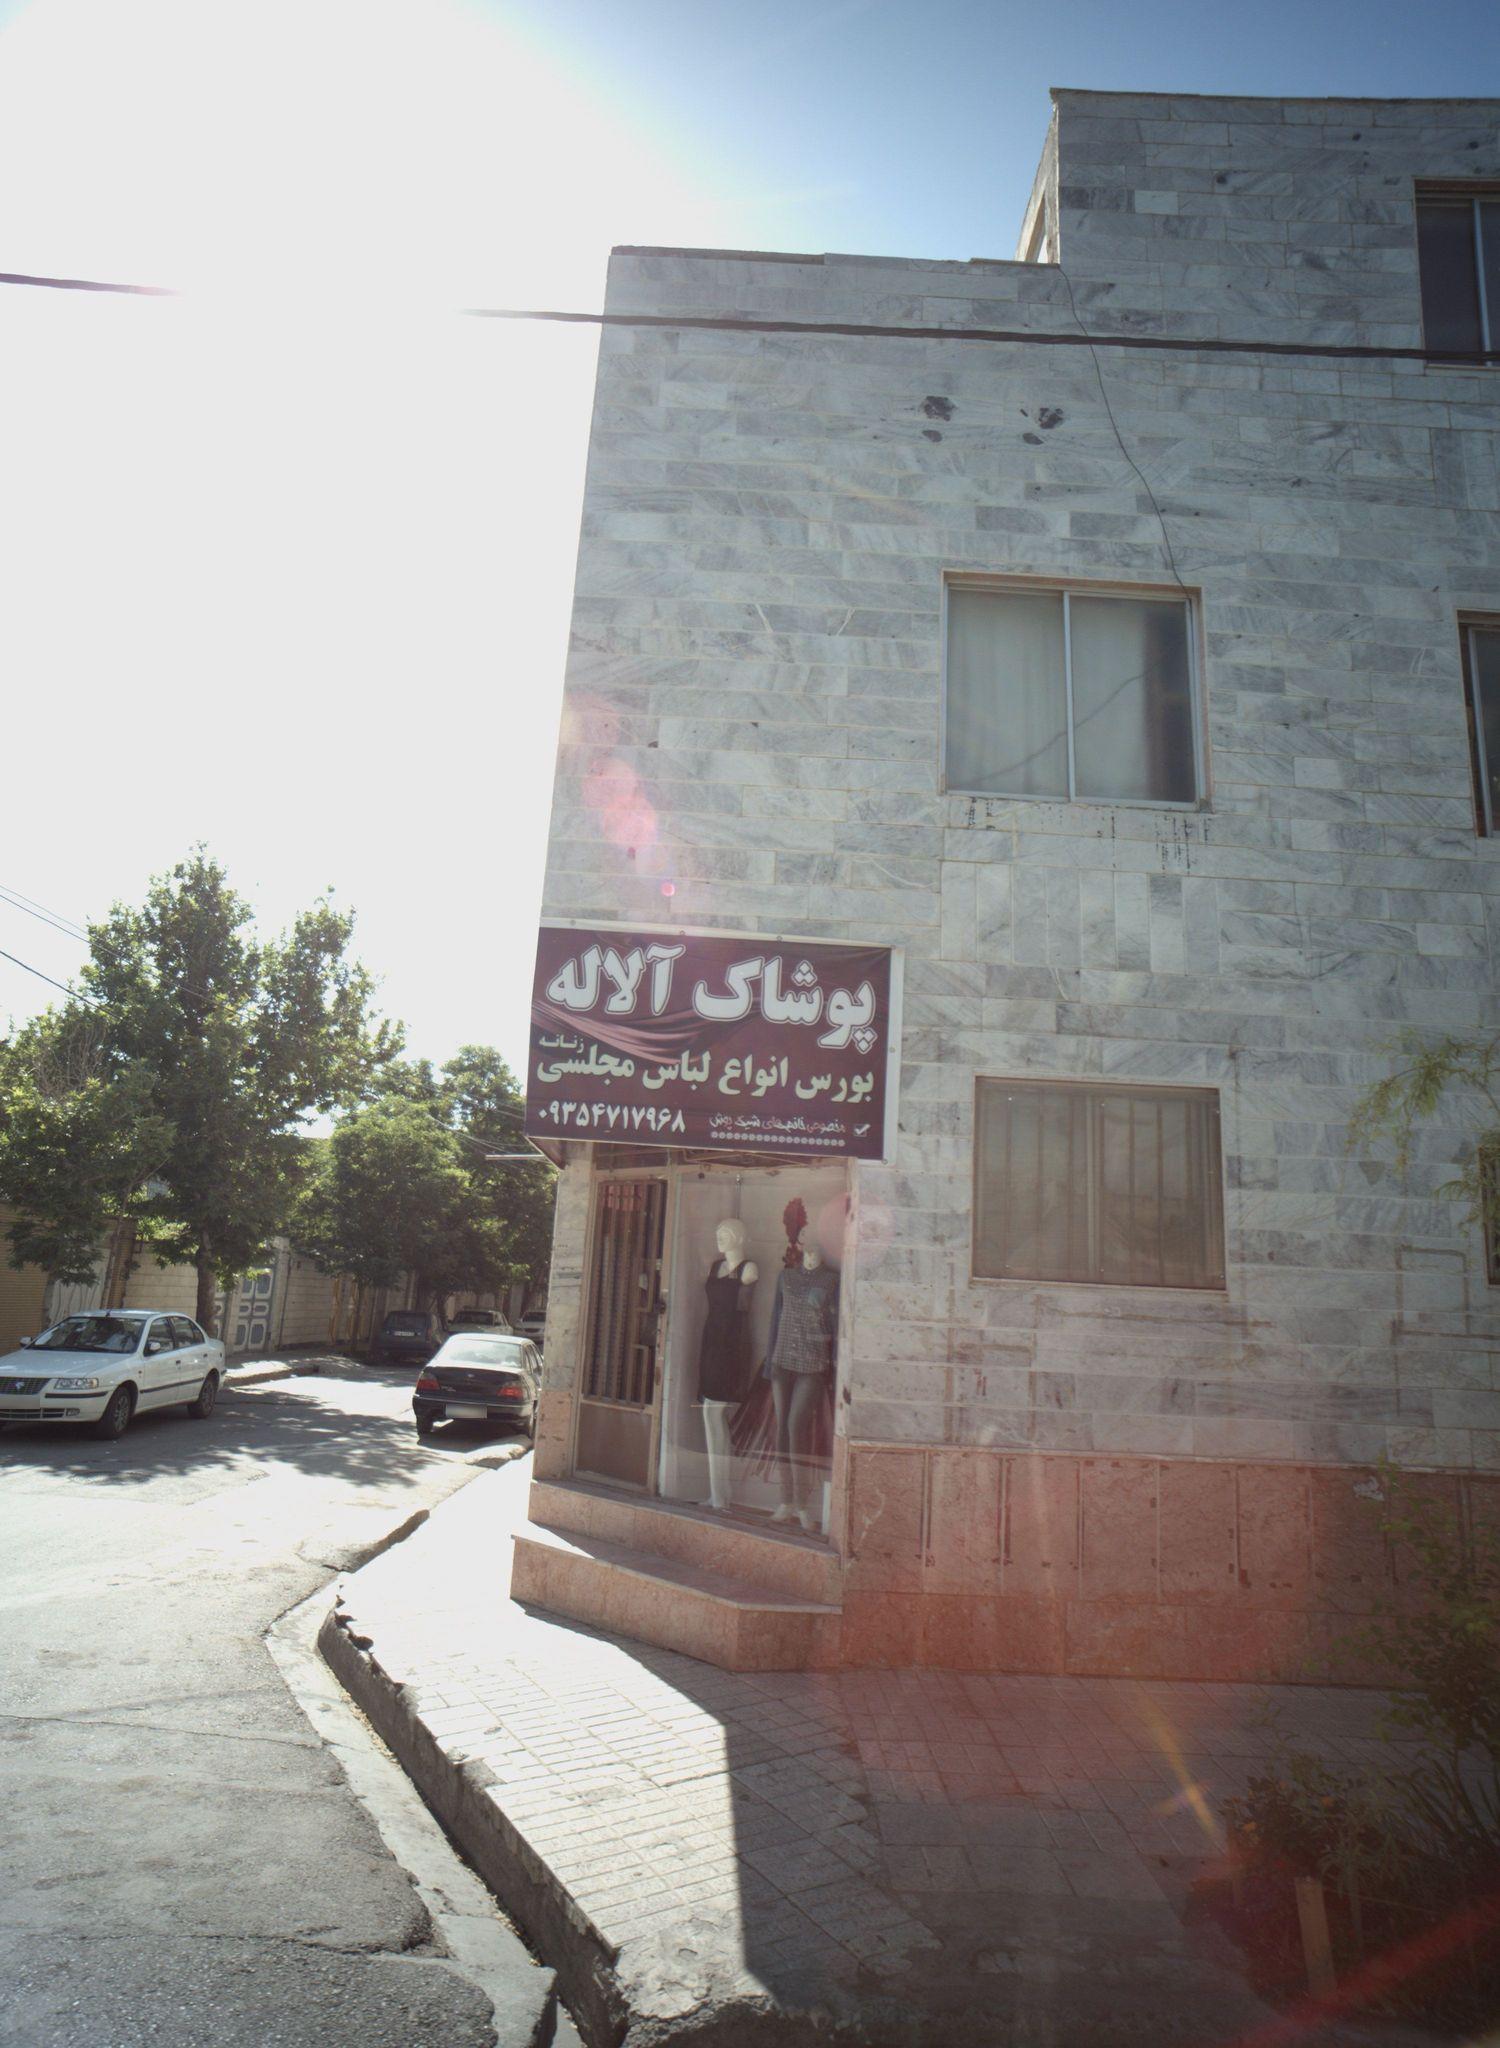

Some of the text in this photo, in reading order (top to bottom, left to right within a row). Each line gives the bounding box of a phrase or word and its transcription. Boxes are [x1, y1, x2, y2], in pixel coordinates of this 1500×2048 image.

[546, 943, 877, 1054] پوشاک آلاله
[539, 1034, 584, 1053] زنانه
[536, 1044, 875, 1103] بورس انواع لباس مجلسی
[538, 1100, 686, 1133] ۰۹۳۵۴۷۱۷۹۶۸
